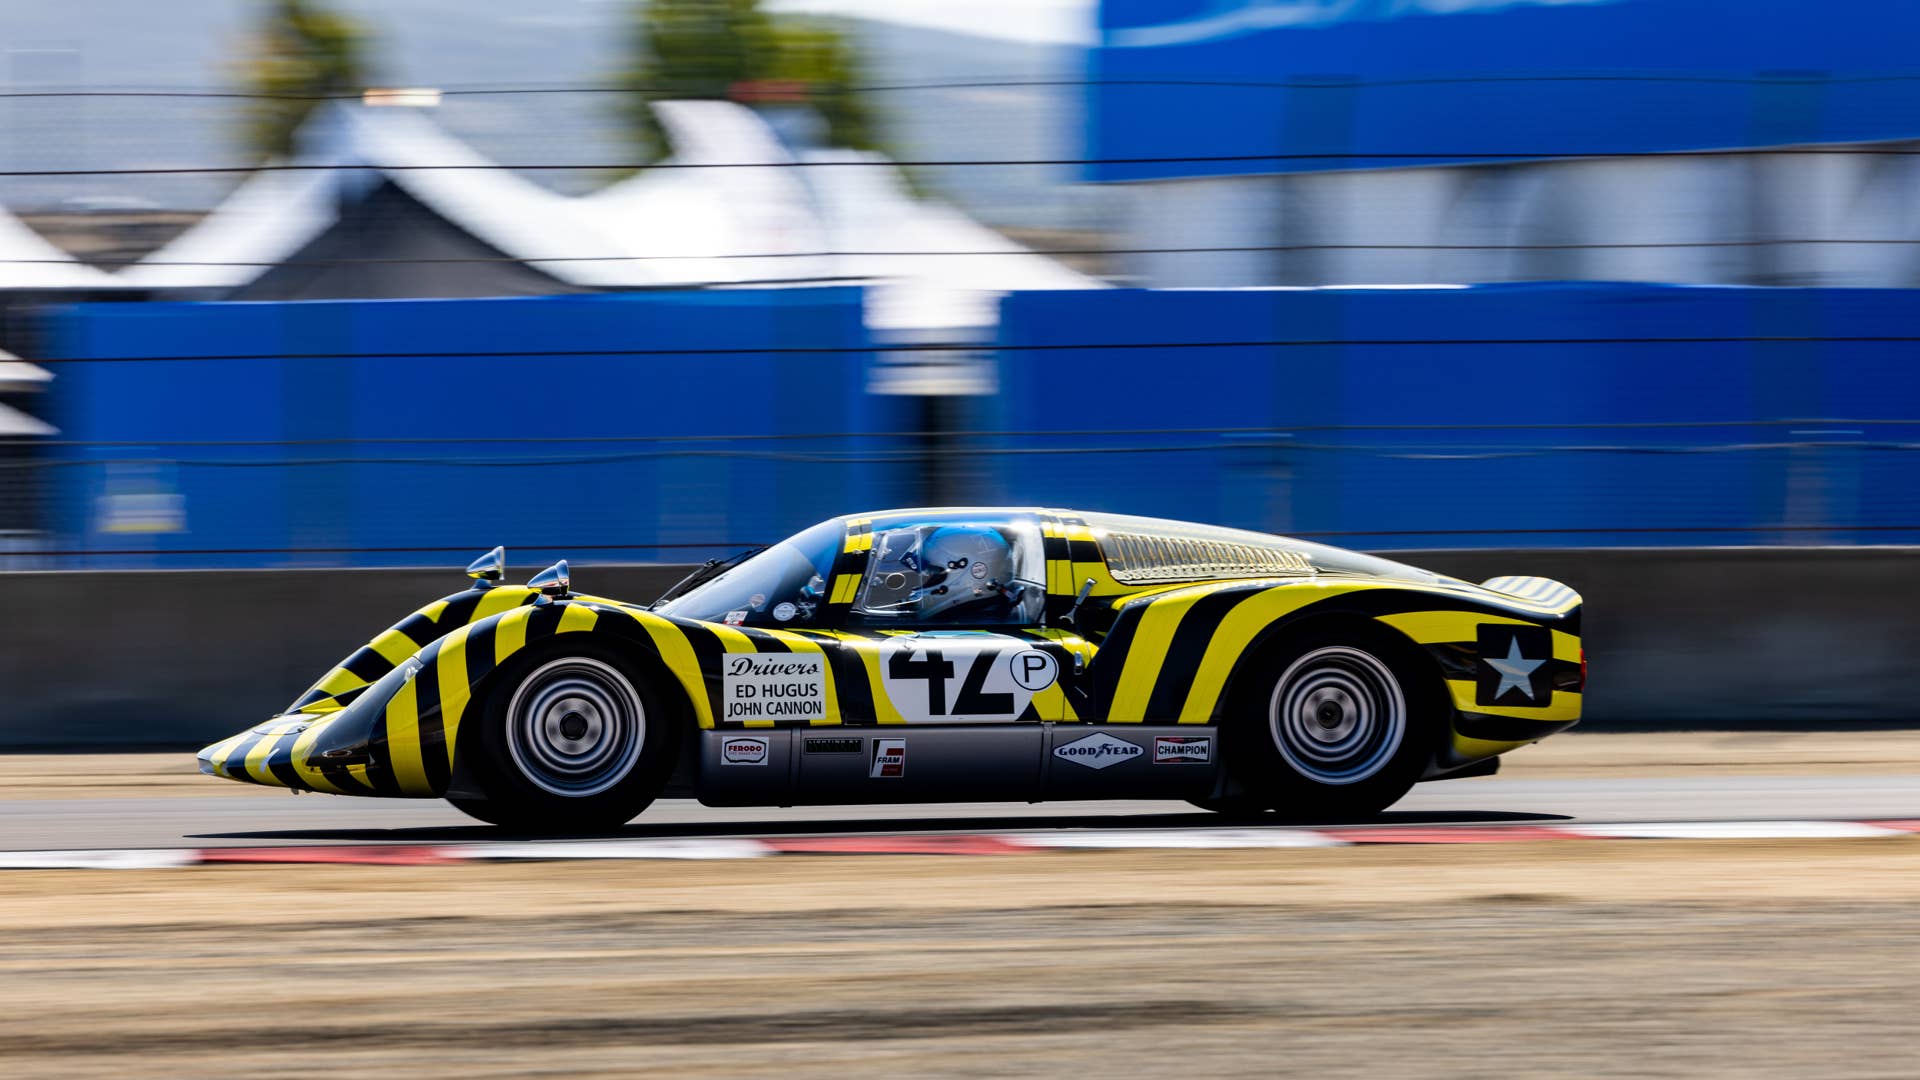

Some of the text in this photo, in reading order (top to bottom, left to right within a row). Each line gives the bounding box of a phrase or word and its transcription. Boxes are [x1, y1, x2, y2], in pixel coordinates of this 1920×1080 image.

[727, 657, 820, 676] Drivers
[1022, 655, 1047, 683] P
[736, 683, 819, 698] ED HUGUS
[888, 648, 1015, 716] 42
[728, 701, 822, 718] JOHN CANNON
[1158, 745, 1207, 755] CHAMPION
[877, 756, 901, 764] FRAM
